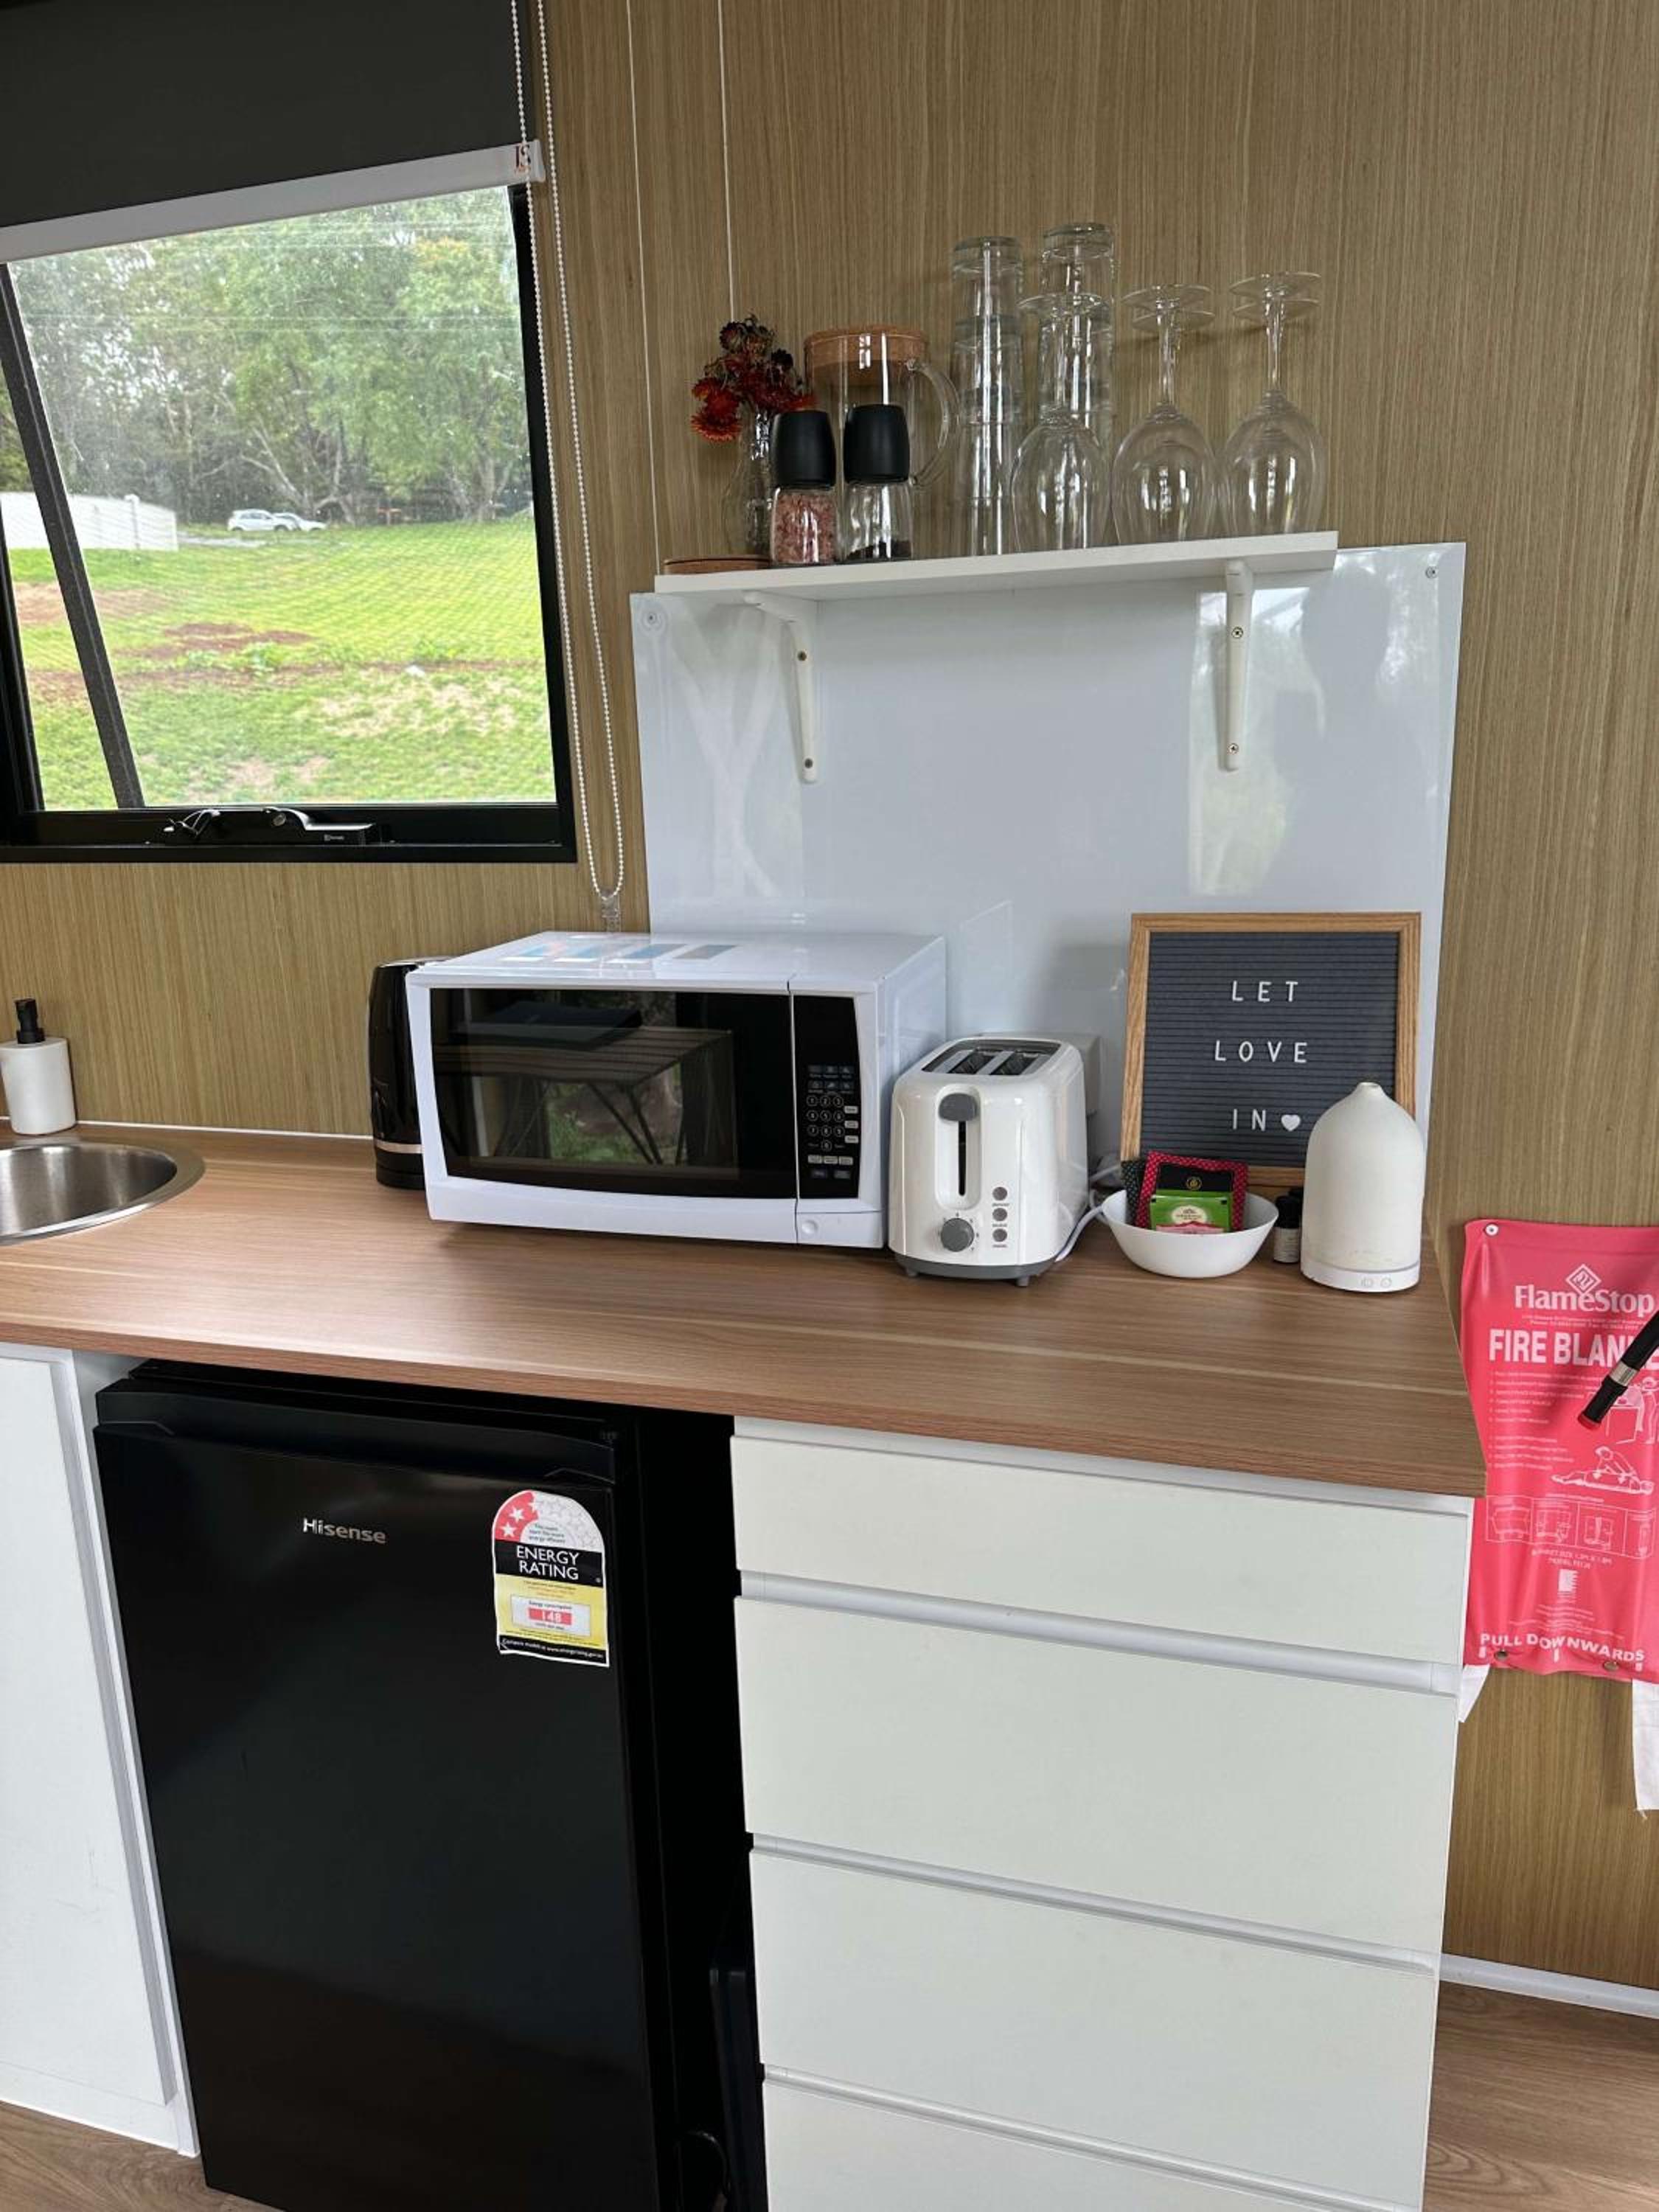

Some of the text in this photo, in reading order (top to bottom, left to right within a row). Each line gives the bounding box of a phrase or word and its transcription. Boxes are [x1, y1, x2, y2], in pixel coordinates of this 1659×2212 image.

[1231, 980, 1298, 1003] LET
[1214, 1040, 1308, 1063] LOVE
[1231, 1109, 1267, 1132] IN
[1514, 1284, 1655, 1318] FlameStop
[1489, 1328, 1548, 1364] FIRE
[302, 1517, 386, 1544] Hisense
[516, 1545, 580, 1566] ENERGY
[518, 1559, 580, 1581] RATING
[1480, 1632, 1645, 1662] PULL DOWNWARDS
